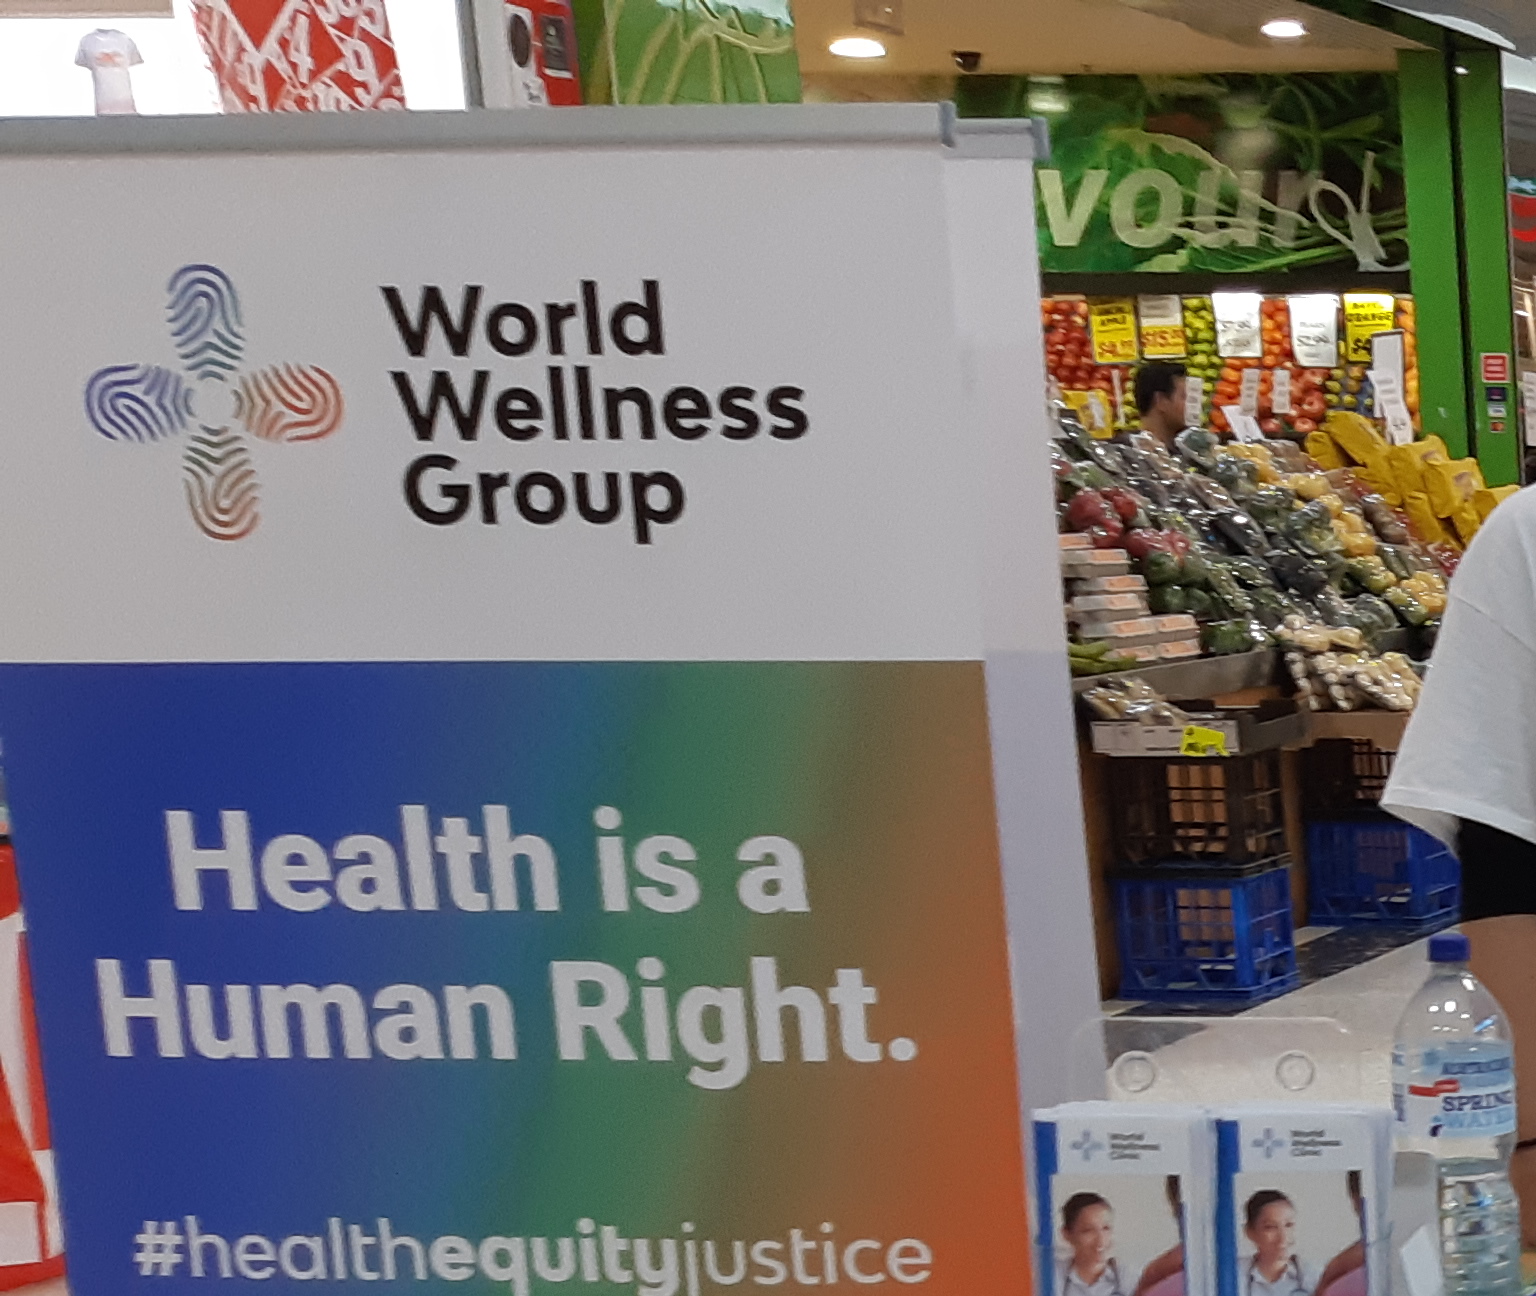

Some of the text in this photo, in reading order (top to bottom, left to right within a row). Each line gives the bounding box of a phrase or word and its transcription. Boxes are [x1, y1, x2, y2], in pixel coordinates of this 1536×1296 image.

[379, 279, 665, 357] World
[388, 365, 809, 441] Wellness
[404, 453, 685, 544] Group
[163, 804, 809, 913] Health is a
[94, 956, 918, 1091] Human Right.
